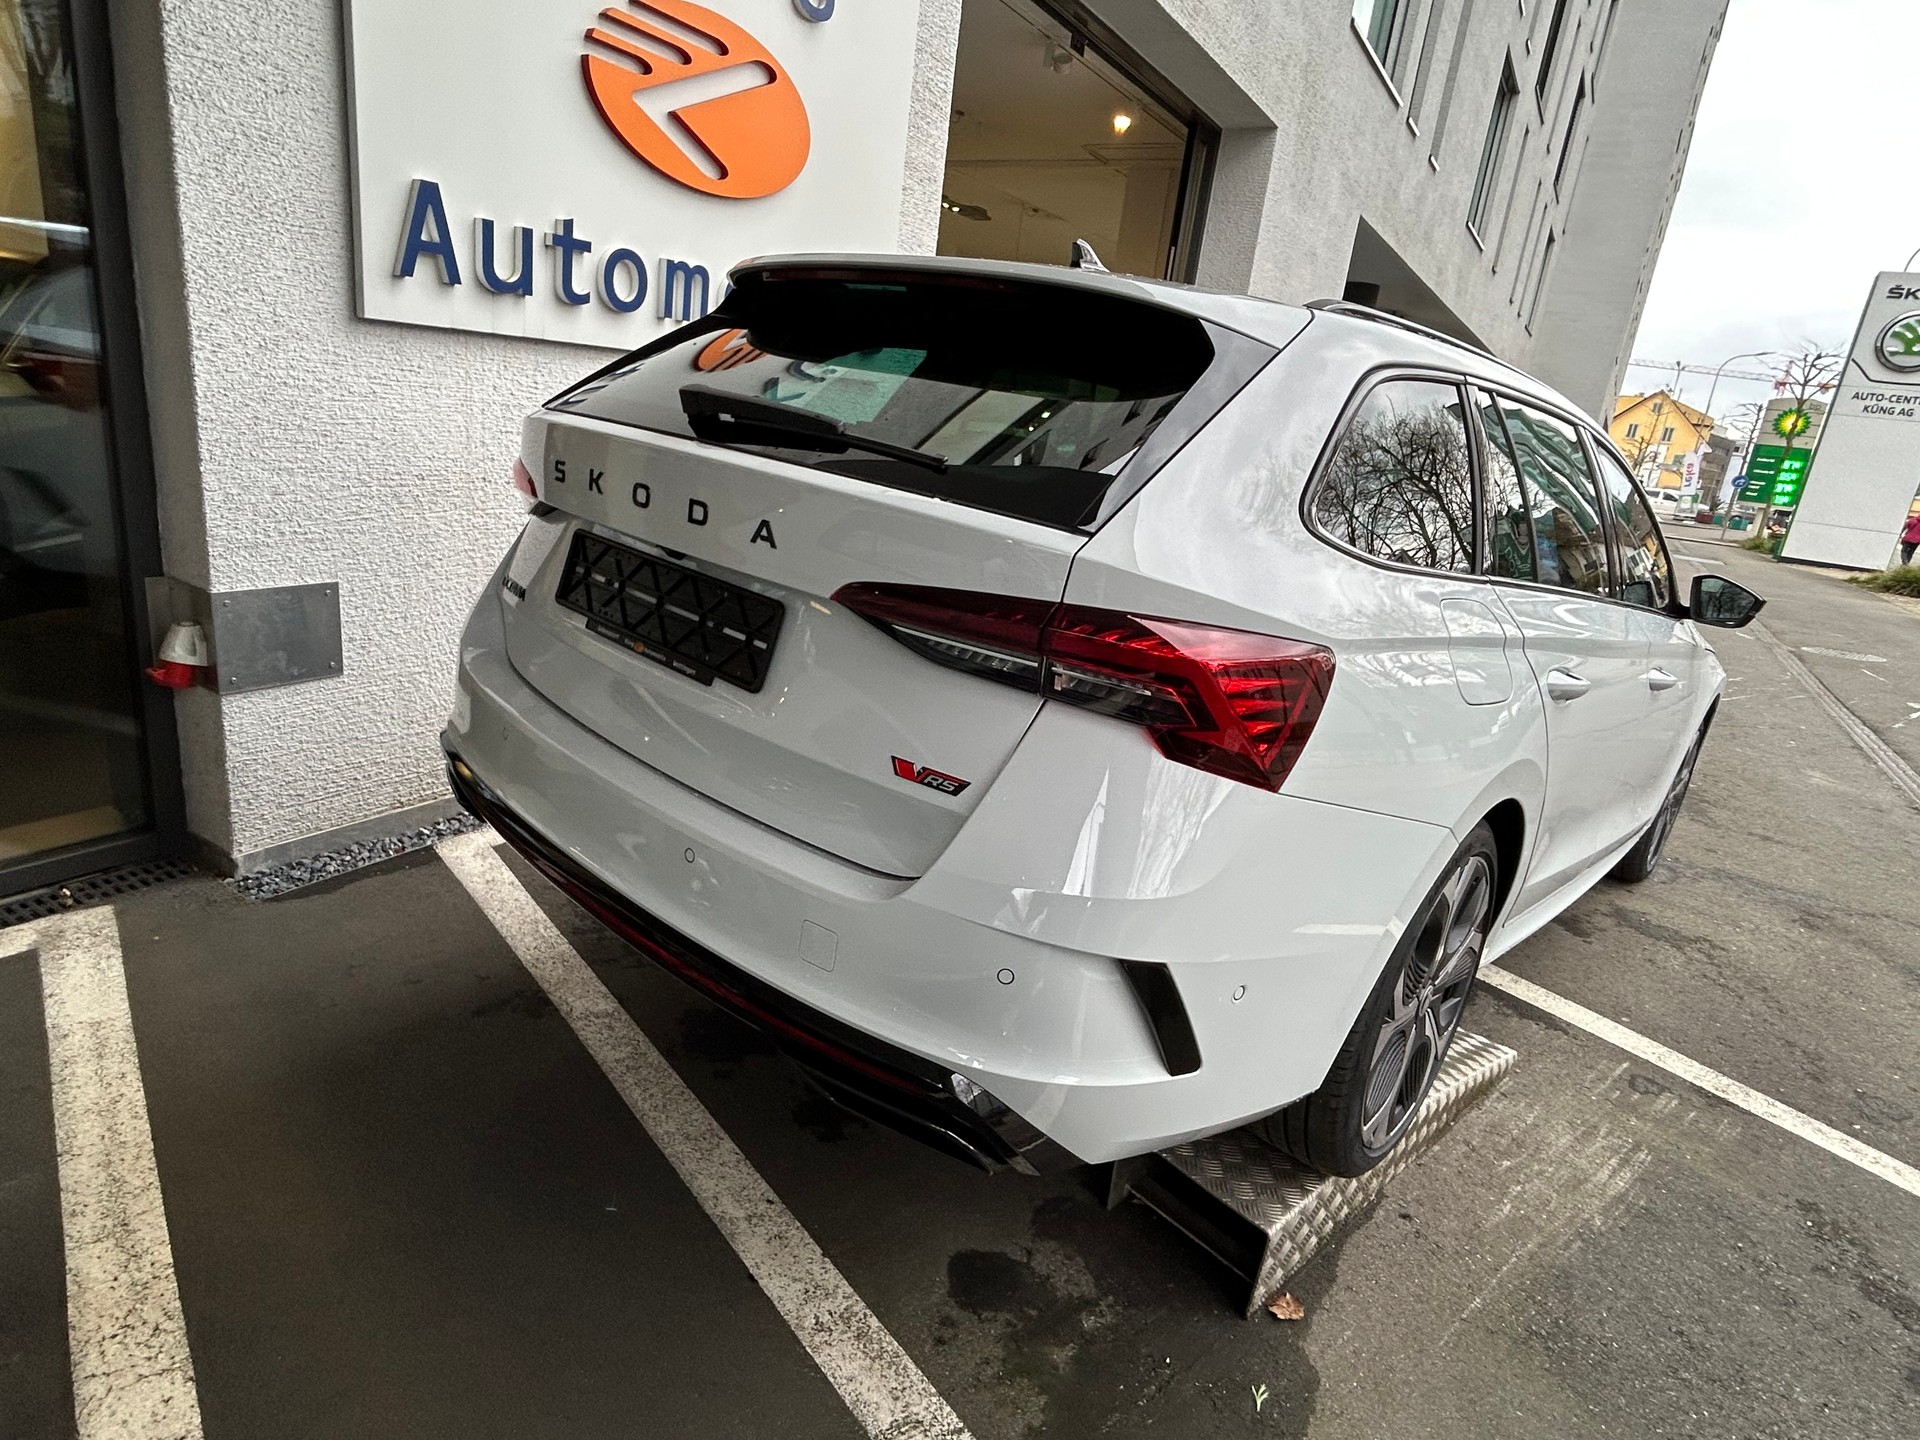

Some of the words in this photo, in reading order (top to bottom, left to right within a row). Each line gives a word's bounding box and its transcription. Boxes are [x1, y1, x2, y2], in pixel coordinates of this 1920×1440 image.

[393, 178, 732, 322] Autom
[1851, 391, 1920, 405] AUTO-CENT
[1862, 403, 1896, 416] KÜNG
[1896, 407, 1915, 417] AG
[554, 459, 778, 550] SKODA
